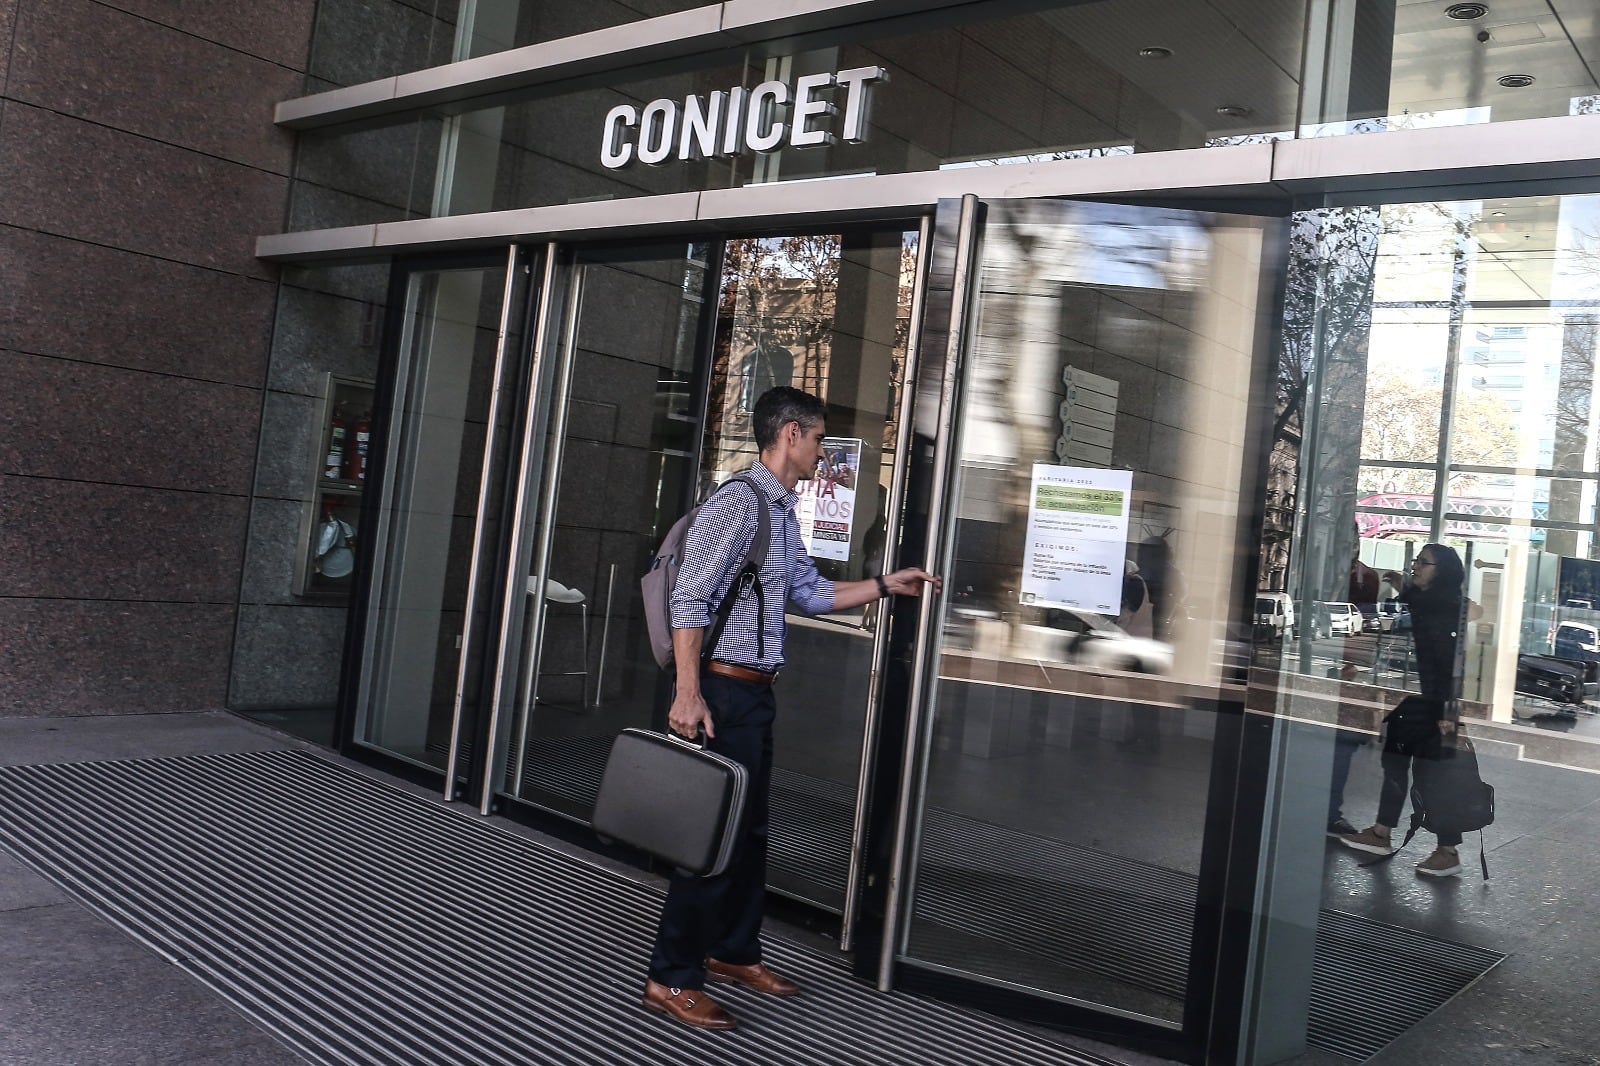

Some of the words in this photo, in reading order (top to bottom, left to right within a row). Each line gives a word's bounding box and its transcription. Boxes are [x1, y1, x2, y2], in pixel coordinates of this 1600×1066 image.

[600, 66, 886, 169] CONICET
[1037, 487, 1092, 500] Rechazamos
[1094, 492, 1102, 500] el
[815, 499, 851, 519] NOS
[1048, 500, 1105, 513] actualización
[813, 531, 838, 541] MINISTA
